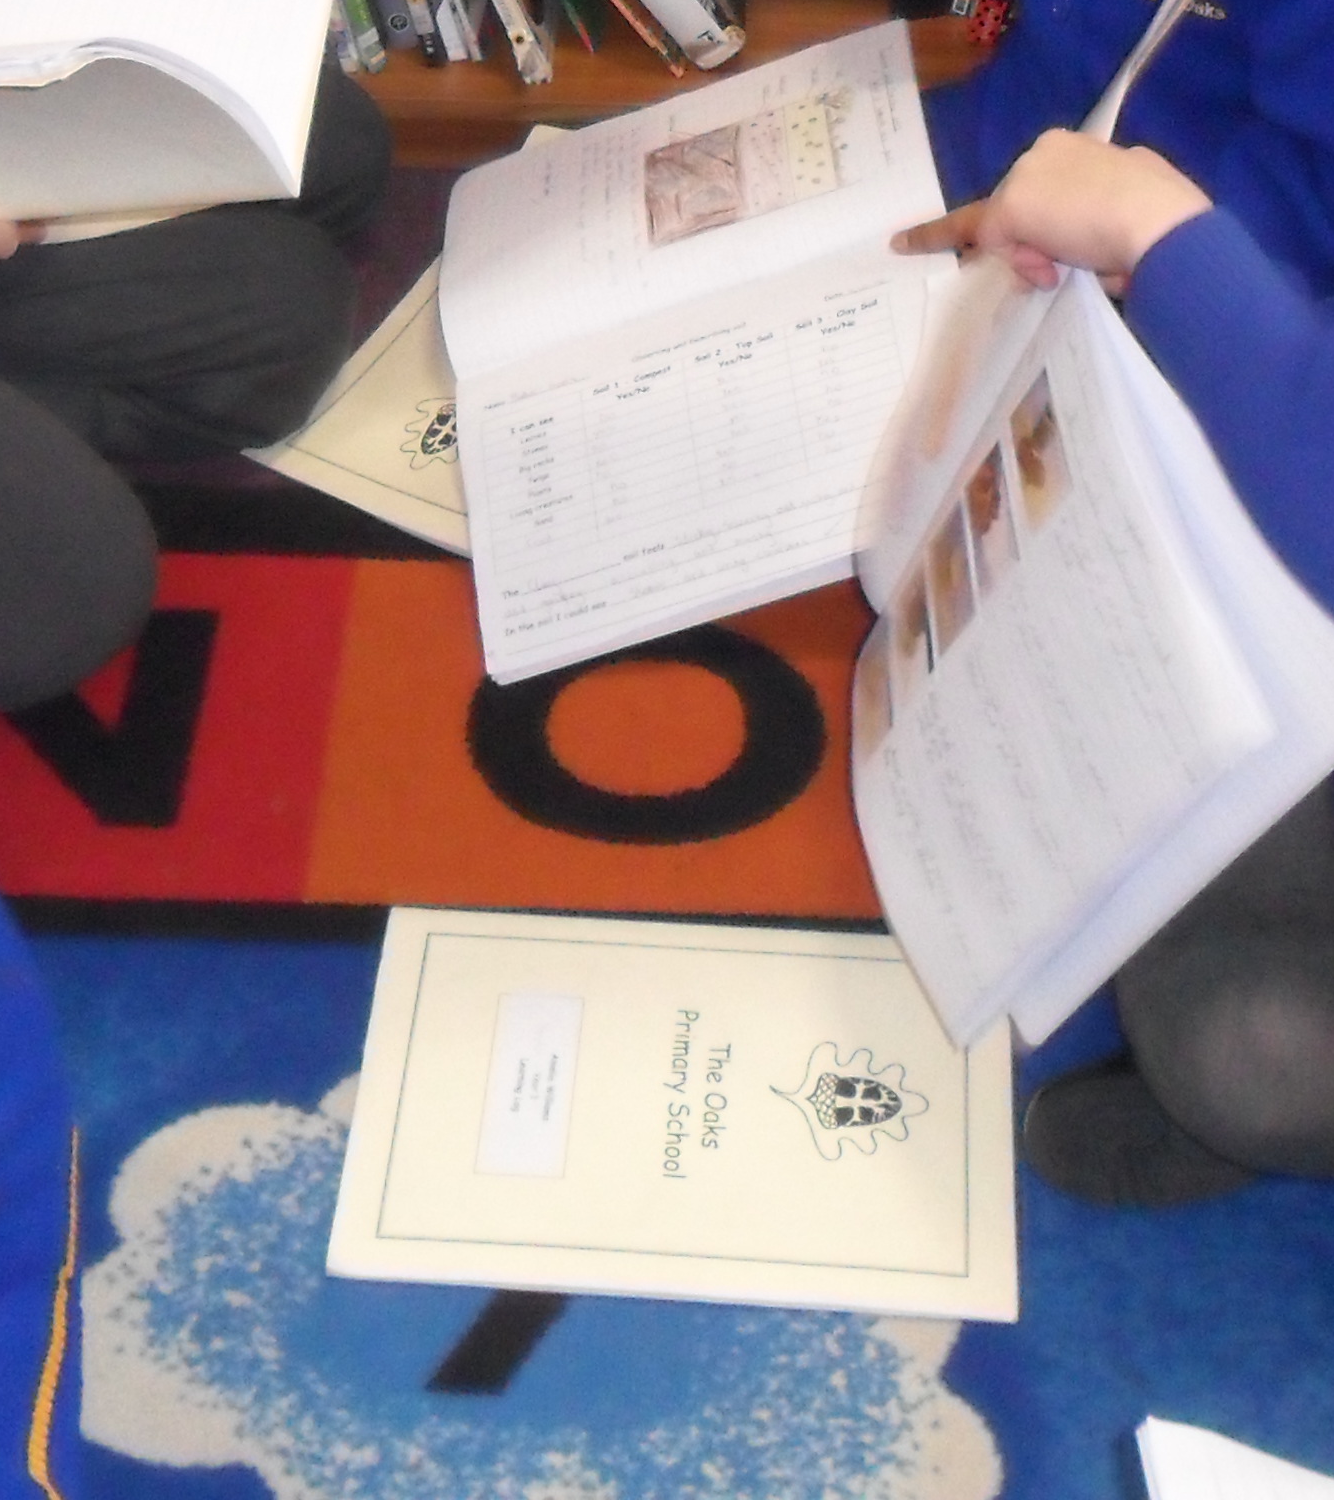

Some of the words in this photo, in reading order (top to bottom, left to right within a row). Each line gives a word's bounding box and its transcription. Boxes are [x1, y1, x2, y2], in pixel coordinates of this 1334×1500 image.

[662, 1008, 700, 1094] Primary
[705, 1043, 732, 1084] The
[662, 1102, 691, 1179] School
[700, 1092, 729, 1150] Oaks
